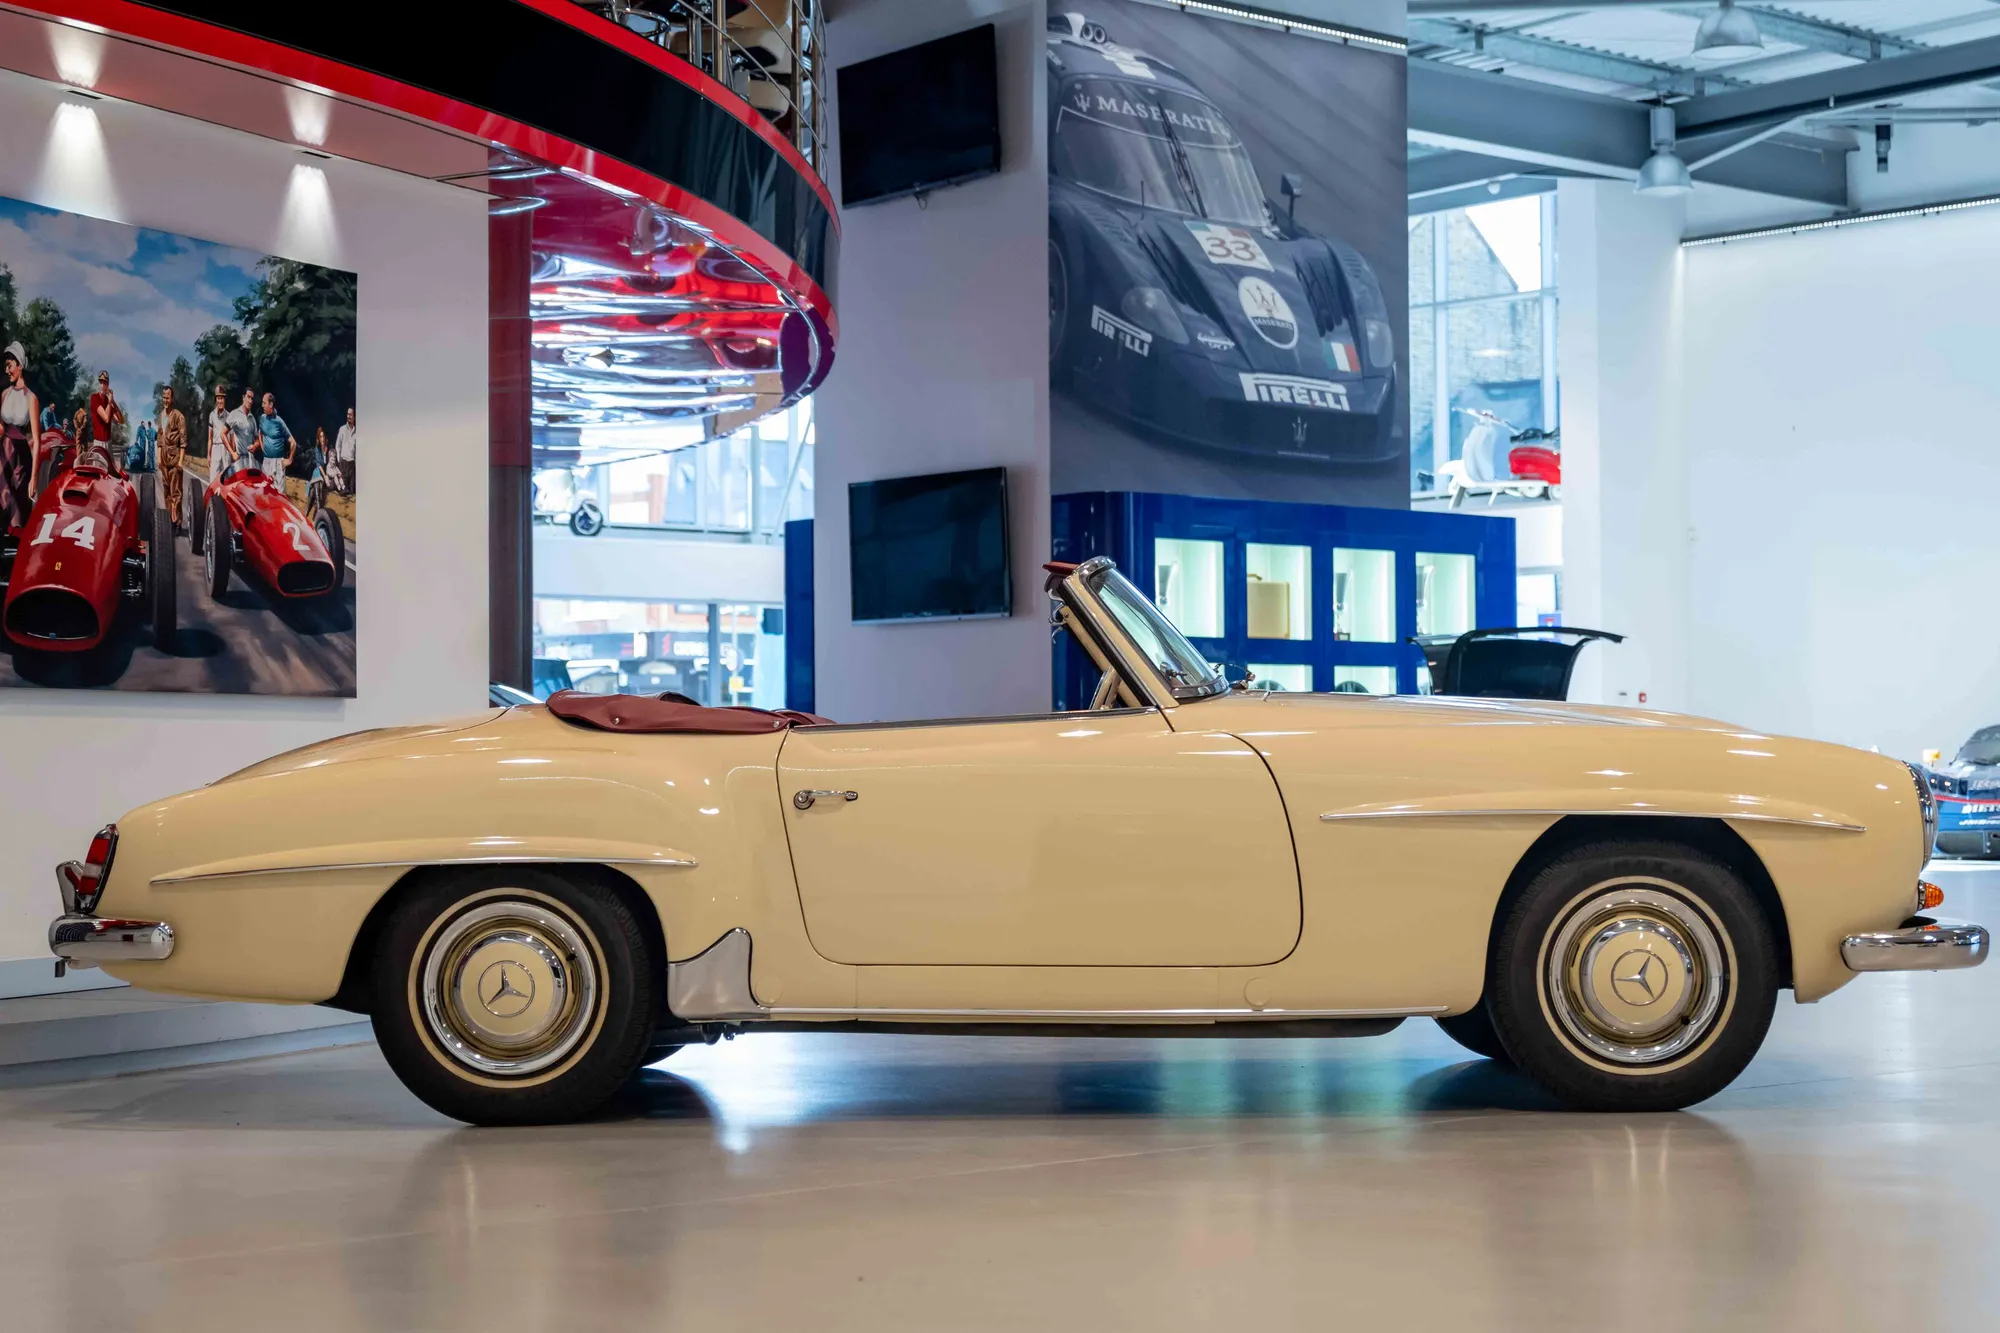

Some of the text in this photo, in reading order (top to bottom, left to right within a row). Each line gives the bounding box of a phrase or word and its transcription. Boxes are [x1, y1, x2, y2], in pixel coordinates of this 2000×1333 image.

[1096, 95, 1219, 134] MASERATI
[1206, 237, 1257, 262] 33
[1238, 372, 1350, 412] PIRELLI
[30, 513, 95, 550] 14
[283, 522, 311, 551] 2
